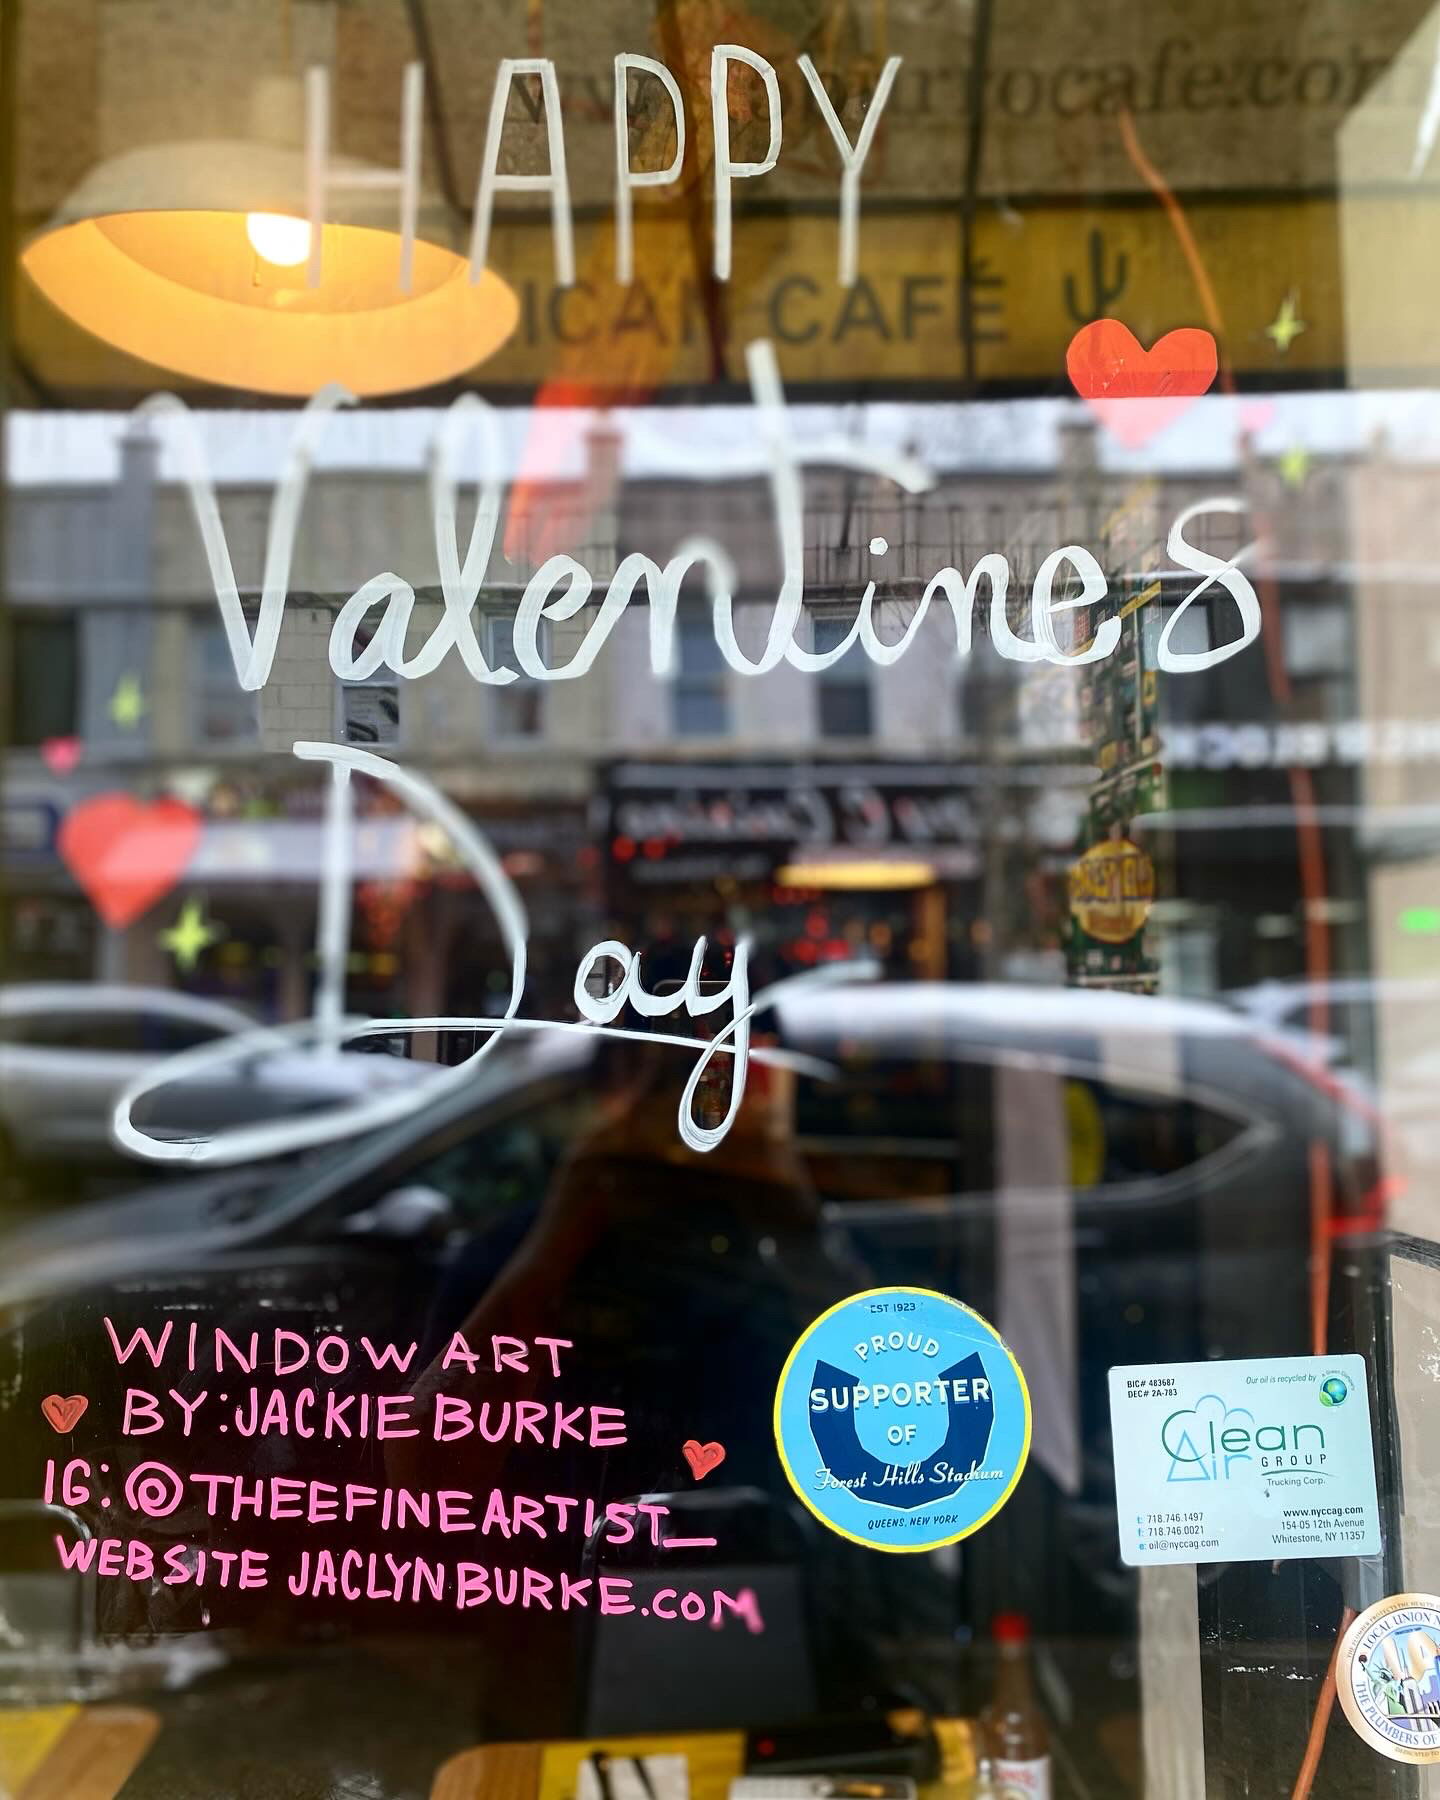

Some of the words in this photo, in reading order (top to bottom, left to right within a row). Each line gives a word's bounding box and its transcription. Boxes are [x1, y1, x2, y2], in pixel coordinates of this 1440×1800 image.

[304, 44, 905, 294] HAPPY
[113, 740, 882, 1165] Day
[870, 1304, 889, 1313] EST
[893, 1302, 916, 1312] 1923
[103, 1316, 418, 1377] WINDOW
[441, 1331, 574, 1378] ART
[854, 1331, 940, 1361] PROUD
[1260, 1375, 1268, 1384] oil
[1277, 1374, 1307, 1385] recycled
[1308, 1372, 1317, 1383] by
[810, 1377, 990, 1411] SUPPORTER
[1151, 1388, 1178, 1397] 2A-783
[433, 1393, 628, 1449] BURKE
[887, 1424, 917, 1445] OF
[1161, 1408, 1326, 1463] Clean
[1166, 1429, 1253, 1482] Air
[1260, 1453, 1327, 1468] GROUP
[814, 1468, 867, 1490] Forest
[872, 1461, 925, 1487] Hills
[928, 1460, 1005, 1484] Stadium
[1266, 1477, 1301, 1488] Trucking
[1303, 1476, 1326, 1487] Corp.
[909, 1515, 930, 1527] NEW
[933, 1514, 959, 1525] YORK
[1147, 1512, 1204, 1524] 718.746.1497
[1283, 1506, 1364, 1518] www.nyccag.com
[1313, 1518, 1331, 1529] 12th
[1334, 1518, 1365, 1528] Avenue
[1147, 1525, 1204, 1537] 718.746.0021
[1271, 1533, 1323, 1544] Whitestone,
[1325, 1531, 1337, 1542] NY
[1339, 1530, 1365, 1541] 11357
[1149, 1539, 1219, 1551] oil@nyccag.com
[55, 1534, 270, 1590] WEBSITE
[1362, 1619, 1393, 1651] LOCAL
[1392, 1610, 1432, 1626] UNION
[1355, 1680, 1371, 1706] THE
[1364, 1705, 1419, 1746] PLUMBERS
[1422, 1734, 1438, 1746] OF
